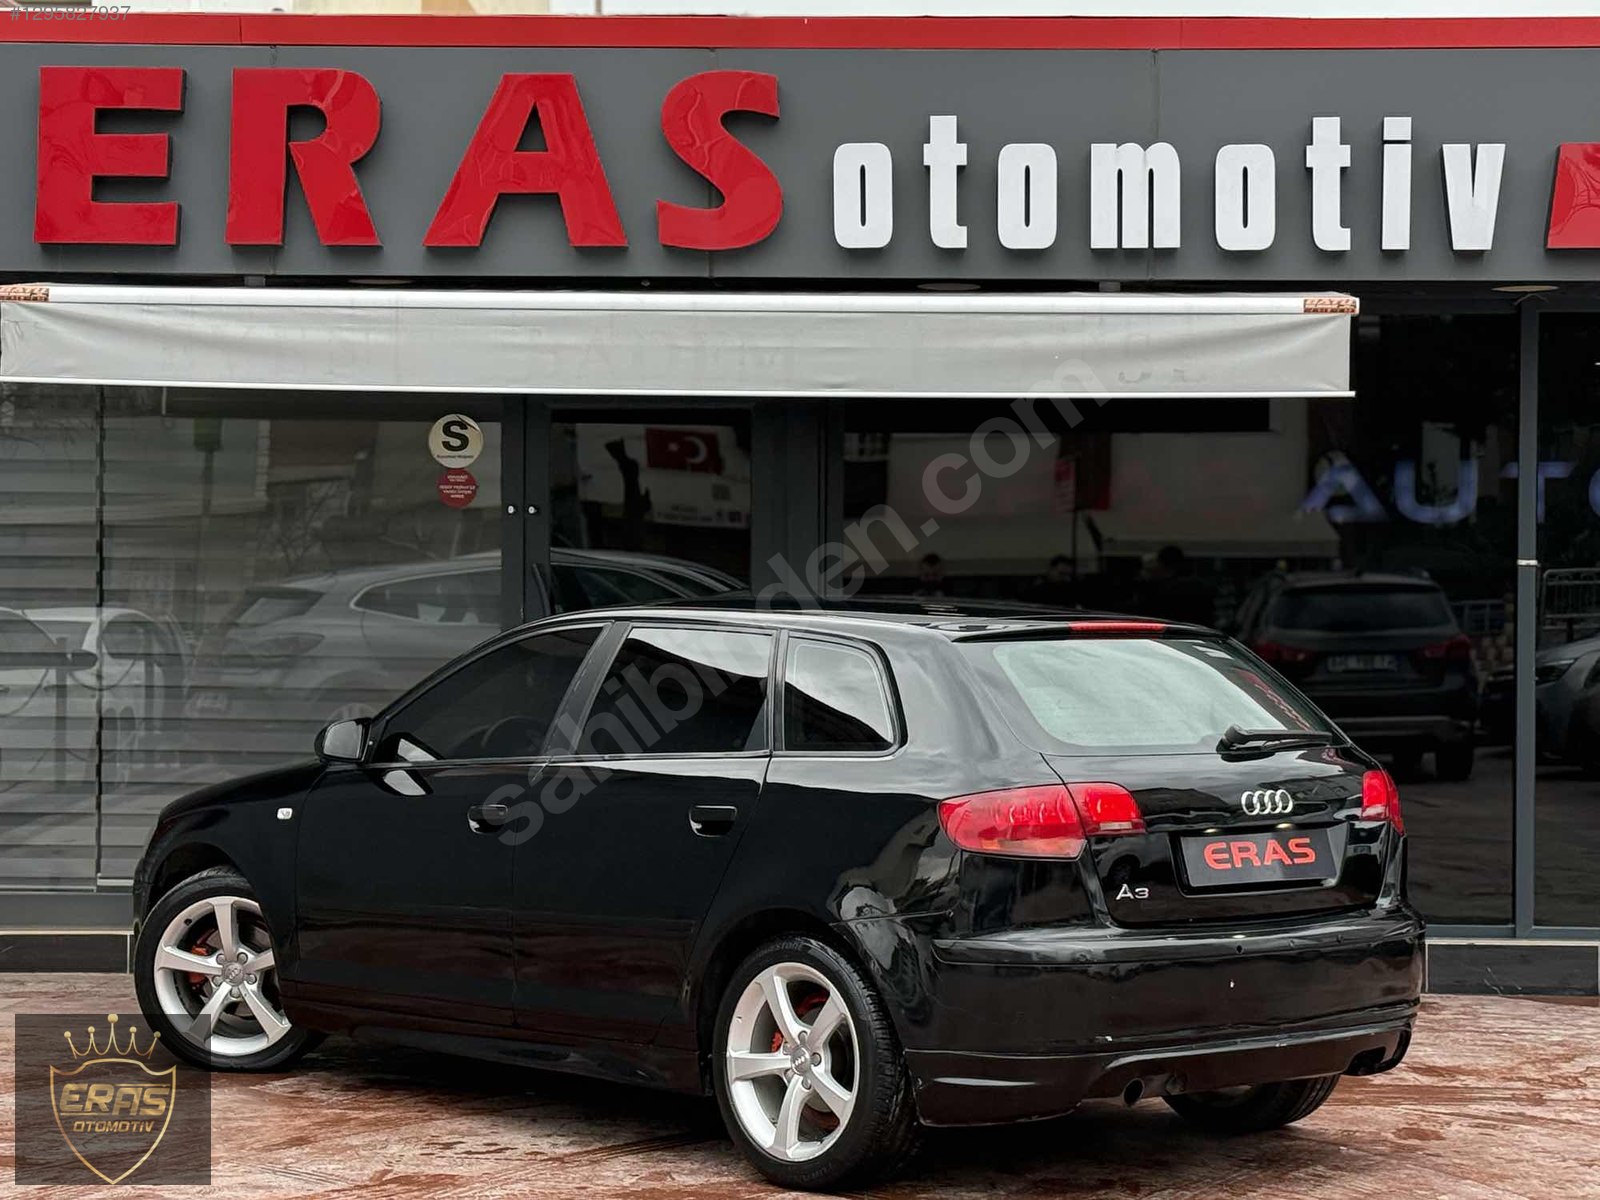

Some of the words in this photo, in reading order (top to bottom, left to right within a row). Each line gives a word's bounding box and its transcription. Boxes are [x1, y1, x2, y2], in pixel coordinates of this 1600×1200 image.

[34, 66, 784, 250] ERAS
[833, 115, 1506, 252] otomotiv
[442, 420, 469, 451] S
[1301, 453, 1600, 524] AUT
[1204, 837, 1316, 869] ERAS
[1115, 884, 1149, 900] A3
